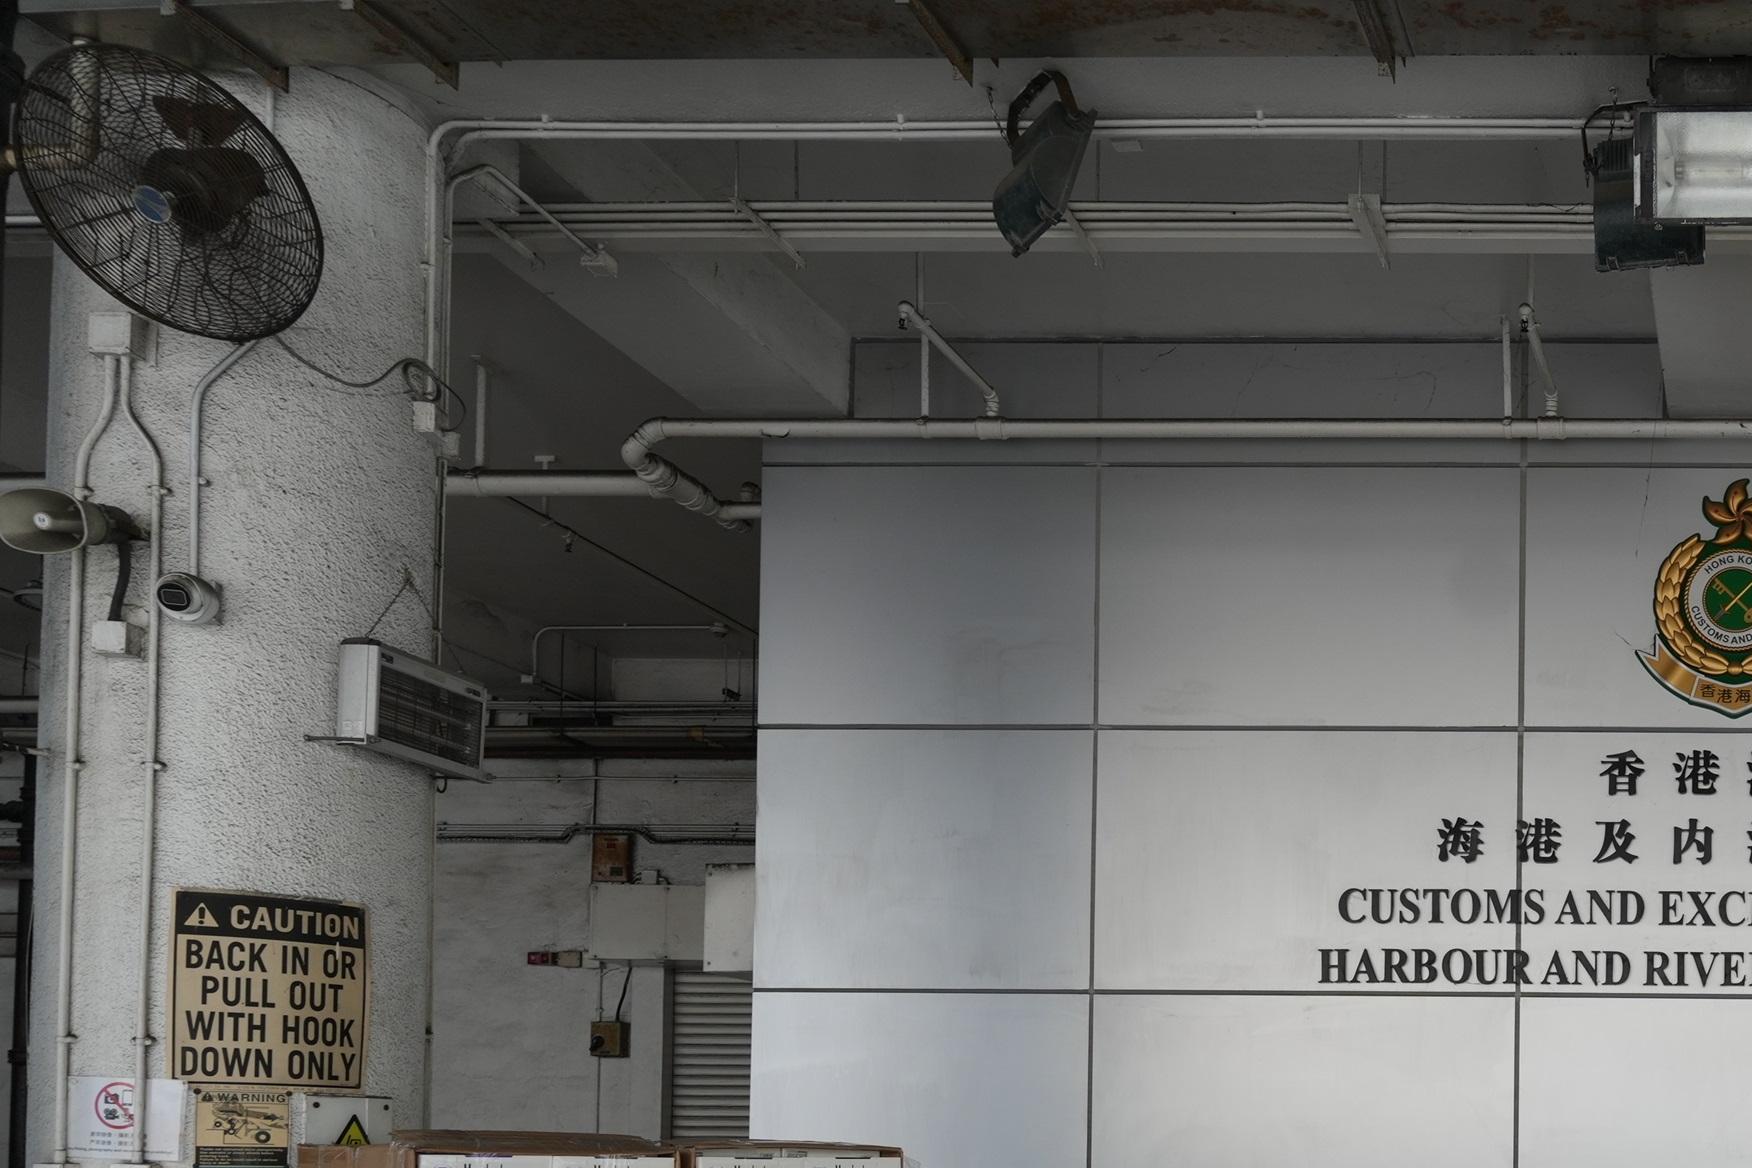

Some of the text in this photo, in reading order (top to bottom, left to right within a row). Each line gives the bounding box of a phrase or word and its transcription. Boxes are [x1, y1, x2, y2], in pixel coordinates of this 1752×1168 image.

[1704, 555, 1734, 574] HONG
[1691, 605, 1729, 643] CUSTOMS
[230, 905, 359, 940] CAUTION
[1338, 887, 1545, 925] CUSTOMS
[1555, 891, 1645, 926] AND
[185, 939, 356, 980] BACK IN OR
[1319, 948, 1531, 986] HARBOUR
[1541, 950, 1631, 986] AND
[201, 975, 343, 1012] PULL OUT
[186, 1010, 355, 1048] WITH HOOK
[180, 1046, 355, 1082] DOWN ONLY
[218, 1093, 285, 1102] WARNING
